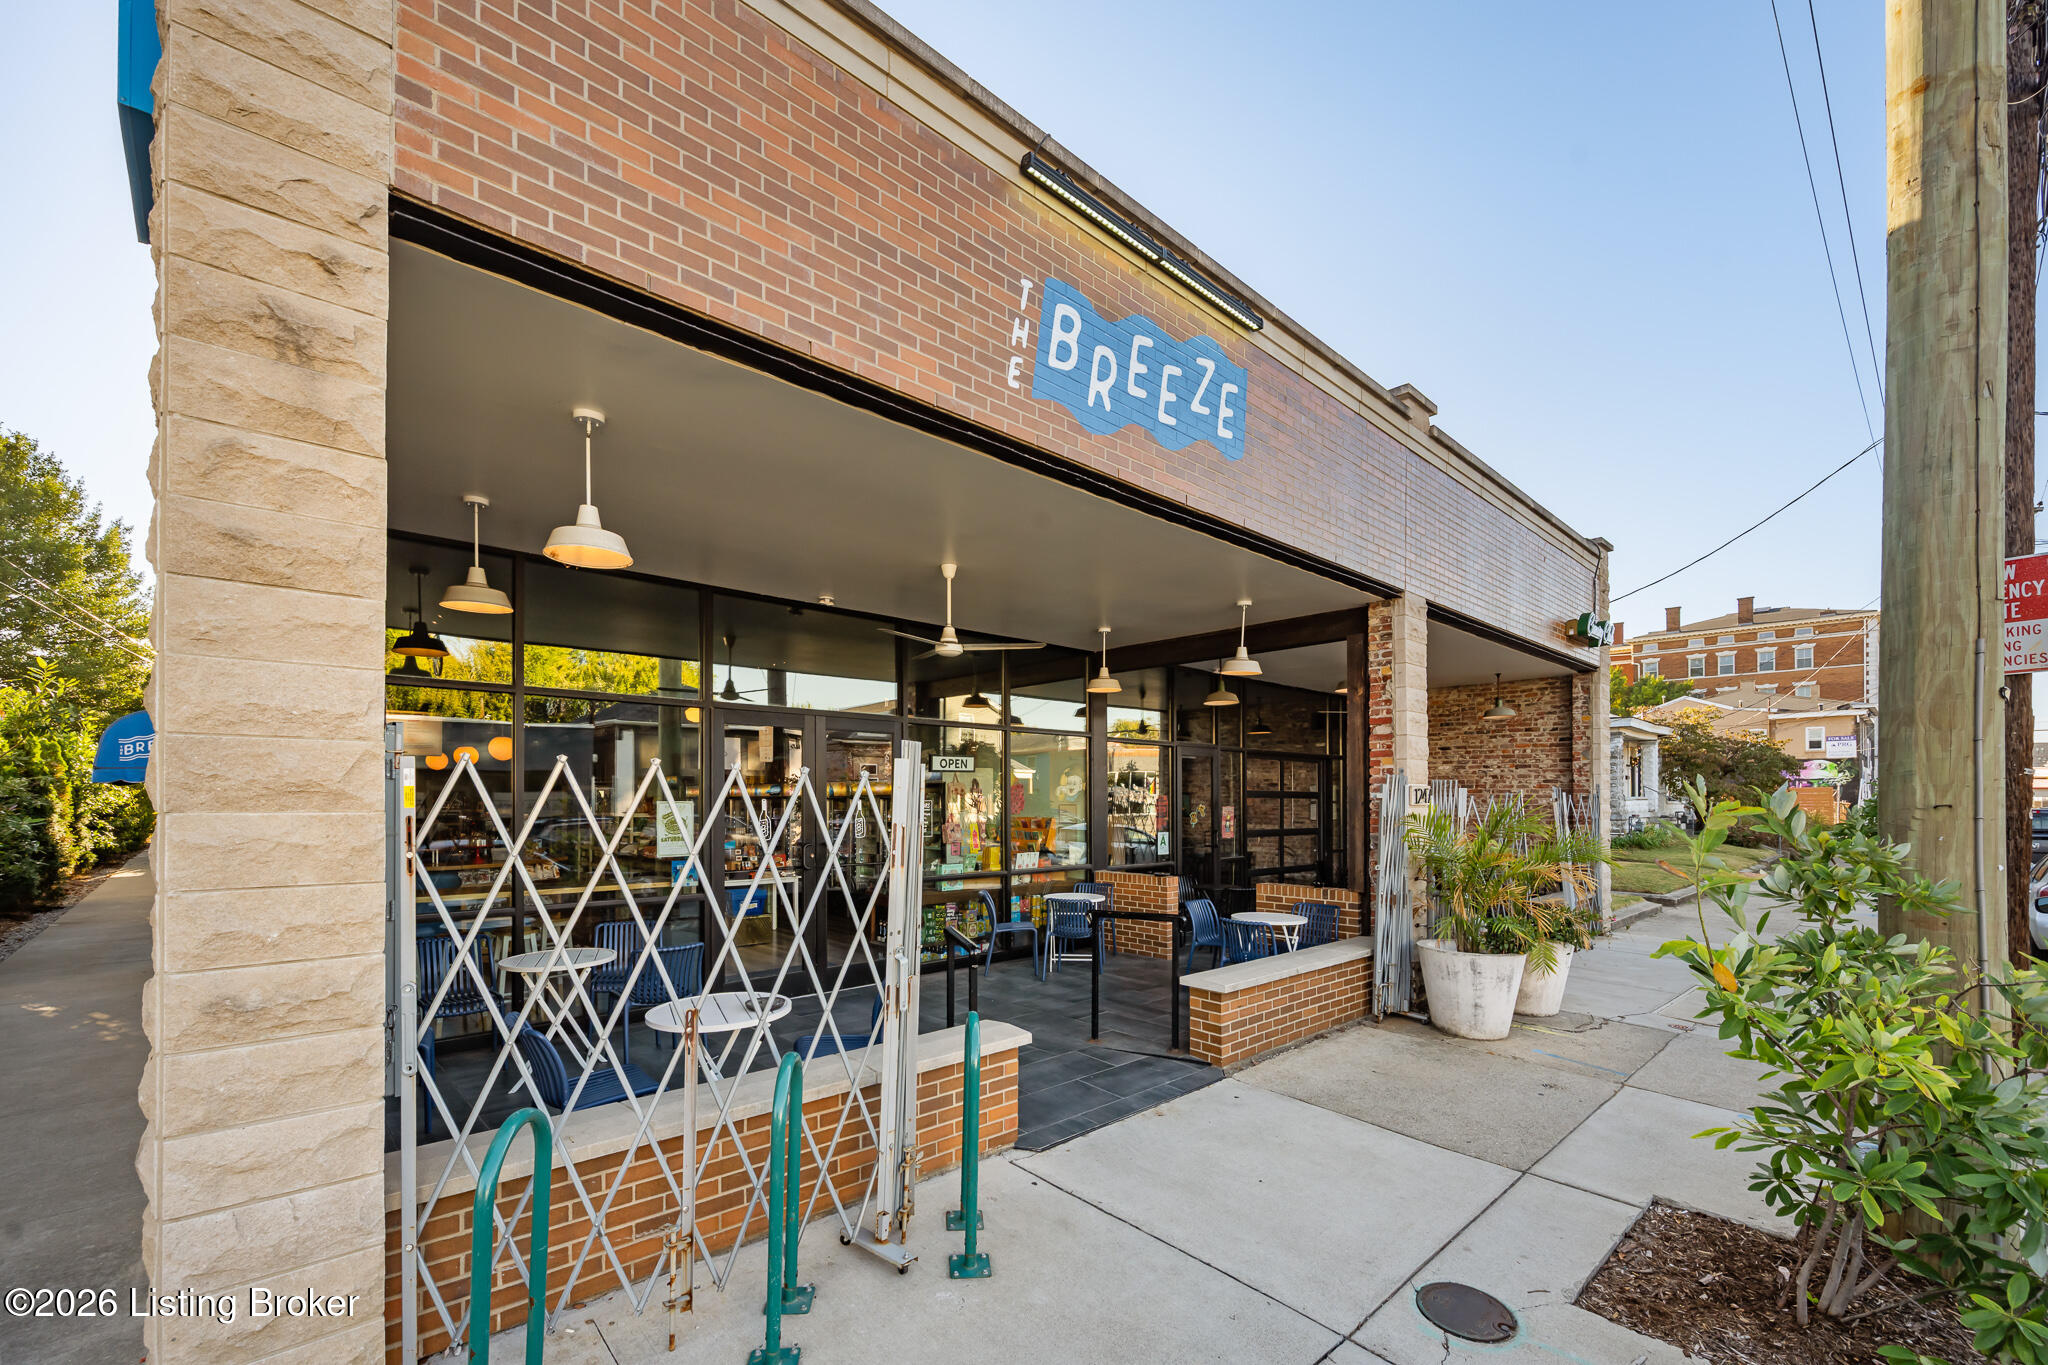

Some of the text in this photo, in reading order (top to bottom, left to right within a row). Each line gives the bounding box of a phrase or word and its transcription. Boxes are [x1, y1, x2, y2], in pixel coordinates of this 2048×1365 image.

[1007, 278, 1034, 389] THE
[1048, 303, 1239, 439] BREEZE
[2006, 623, 2042, 638] KING
[2004, 640, 2022, 652] NG
[2004, 652, 2048, 667] NCIES
[939, 758, 968, 769] OPEN
